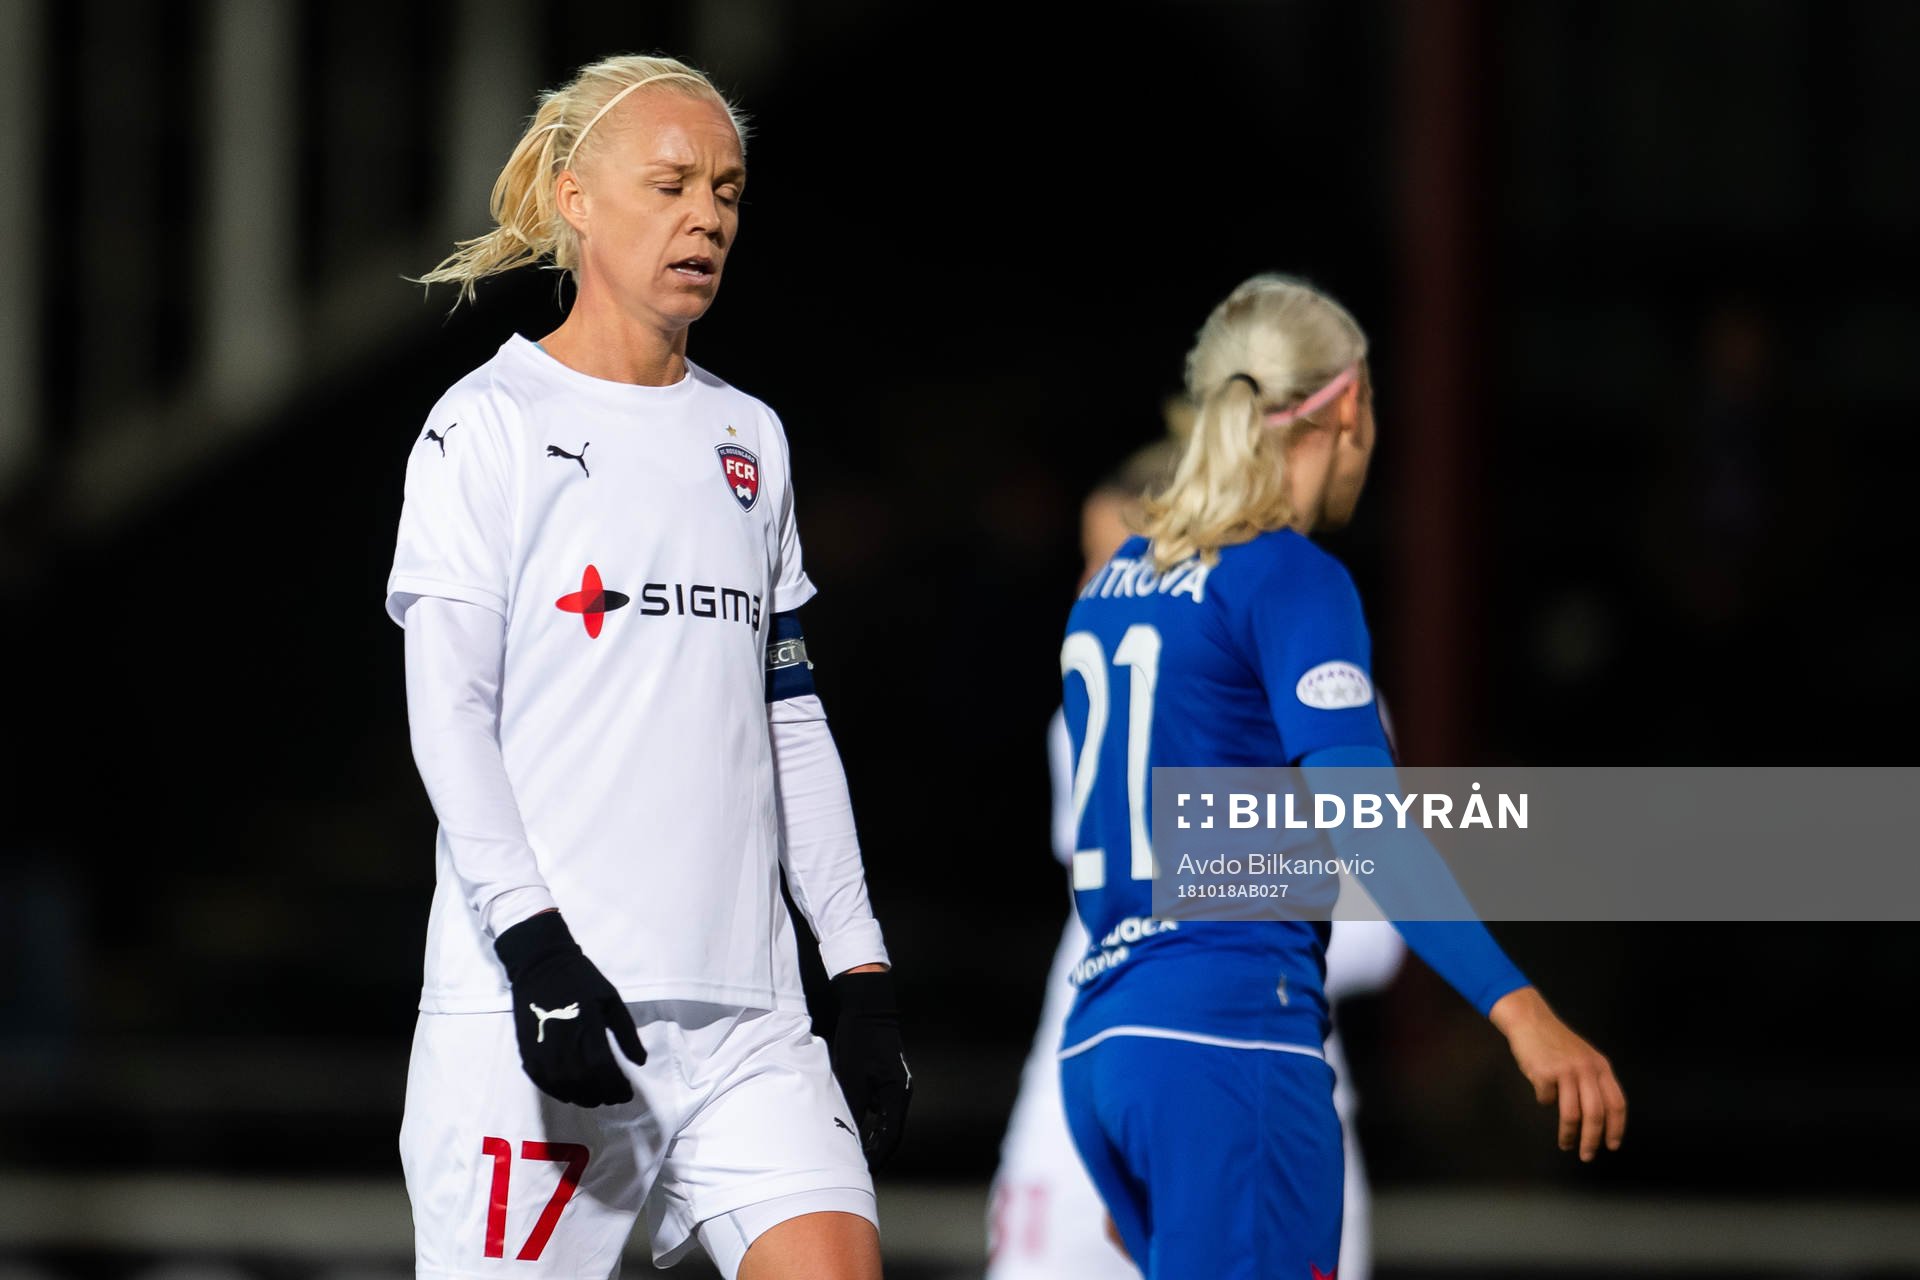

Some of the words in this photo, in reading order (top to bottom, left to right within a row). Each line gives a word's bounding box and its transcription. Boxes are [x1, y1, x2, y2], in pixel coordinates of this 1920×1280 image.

[726, 459, 756, 481] FCR
[1060, 623, 1162, 892] 21
[482, 1136, 590, 1261] 17
